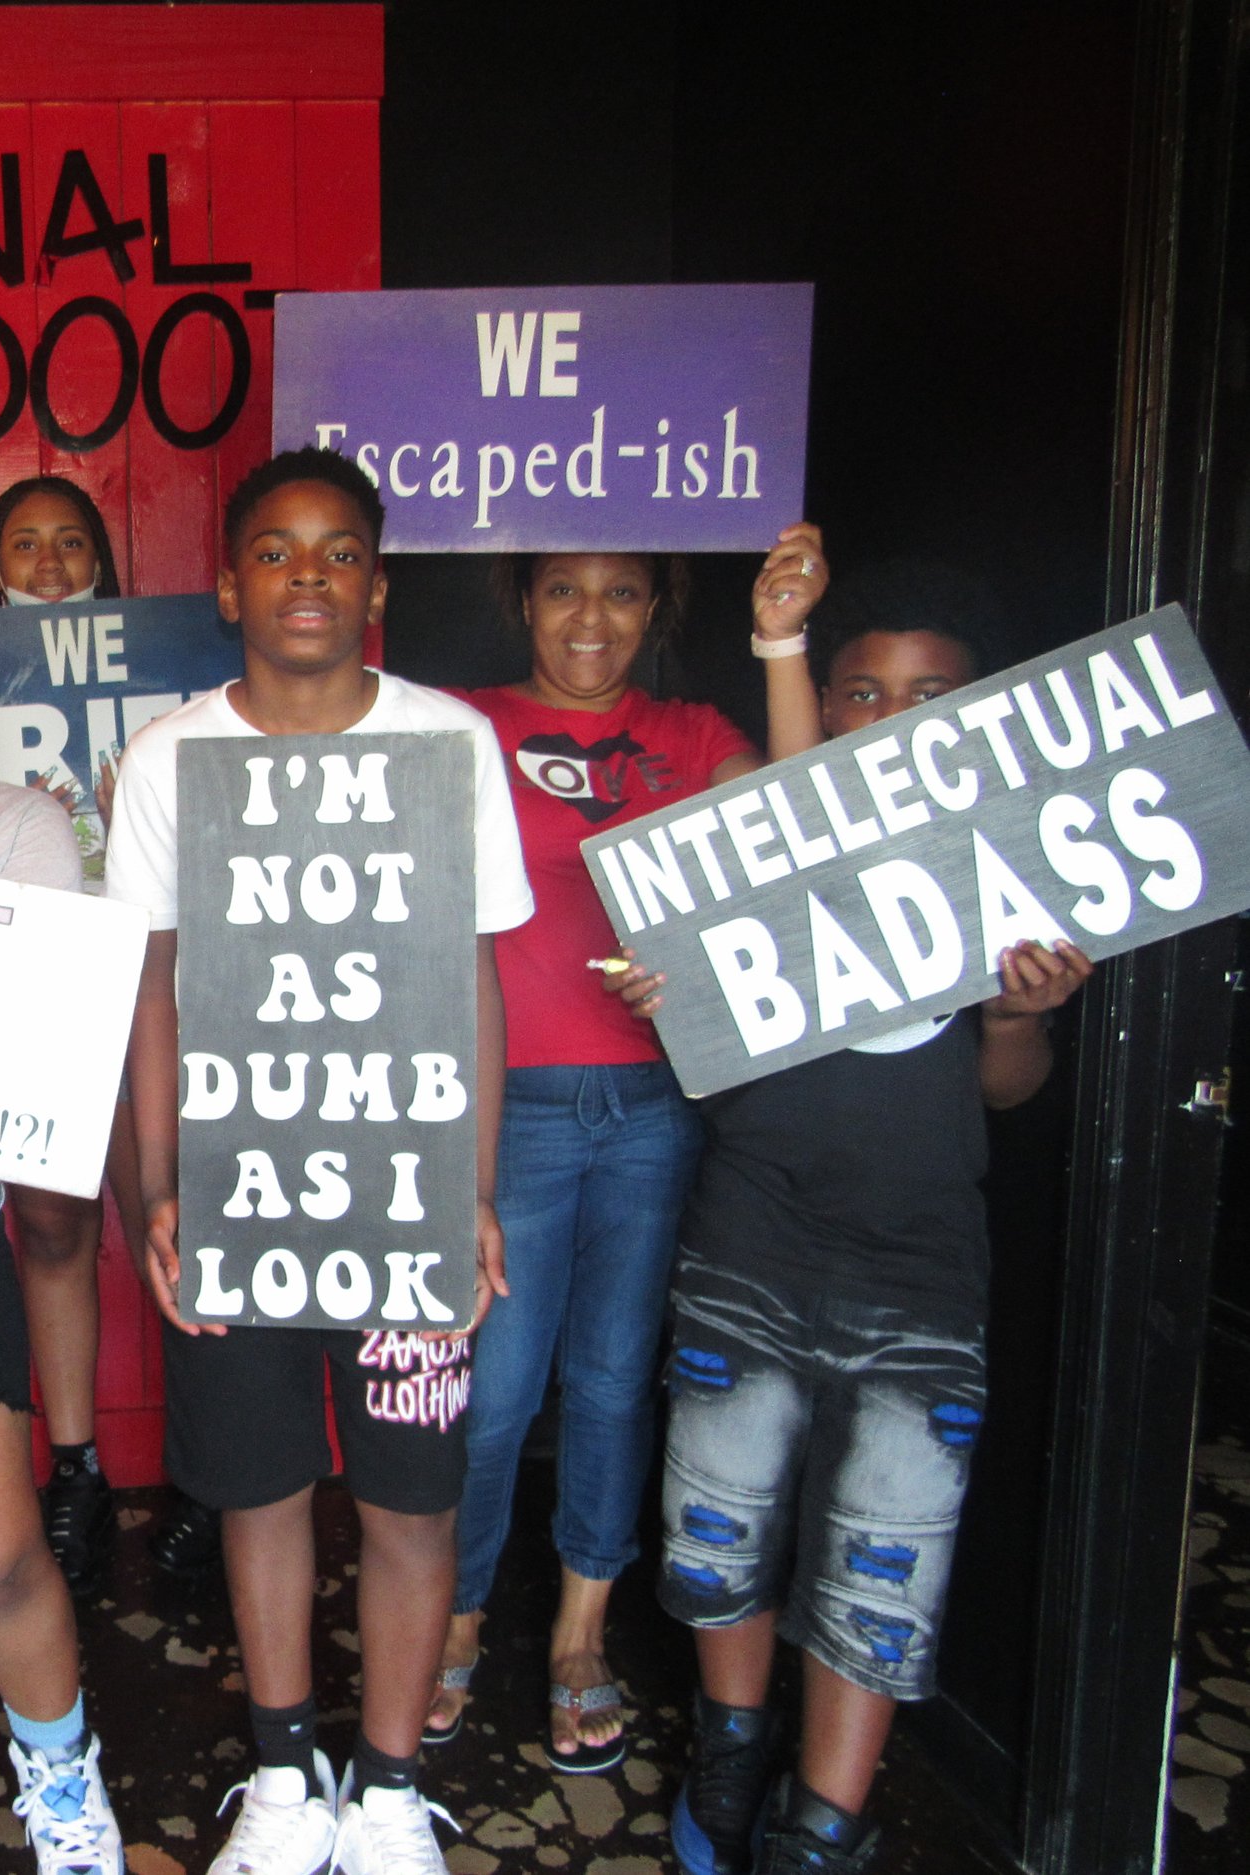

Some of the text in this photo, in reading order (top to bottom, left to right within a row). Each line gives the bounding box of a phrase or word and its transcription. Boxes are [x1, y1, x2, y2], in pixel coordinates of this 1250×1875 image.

[476, 311, 581, 397] WE
[40, 614, 128, 686] WE
[242, 753, 396, 826] I'M
[598, 634, 1215, 932] INTELLECTUAL
[225, 851, 415, 925] NOT
[699, 768, 1203, 1057] BADASS
[256, 951, 383, 1023] AS
[180, 1051, 468, 1123] DUMB
[223, 1149, 425, 1222] AS I
[195, 1247, 455, 1322] LOOK
